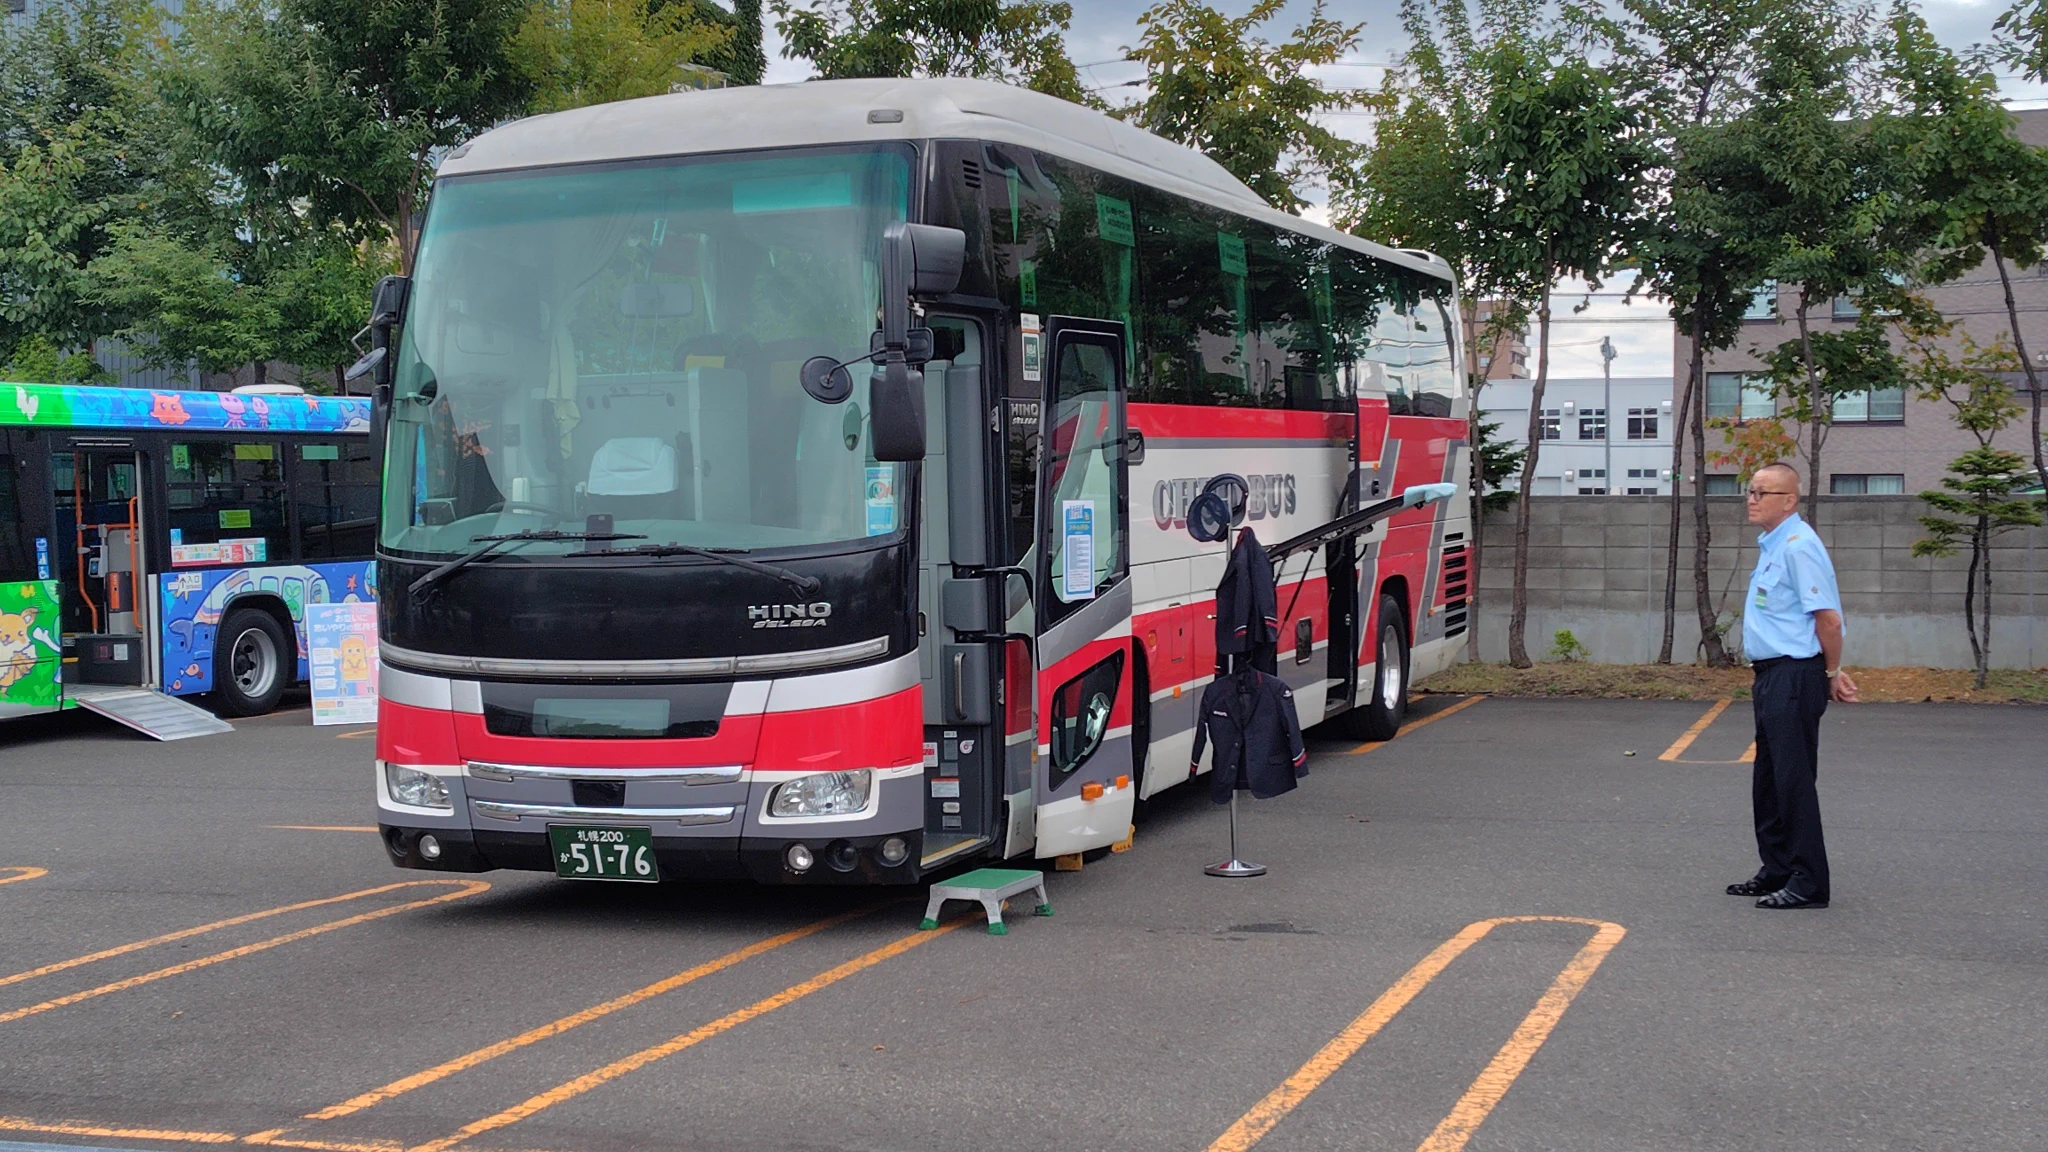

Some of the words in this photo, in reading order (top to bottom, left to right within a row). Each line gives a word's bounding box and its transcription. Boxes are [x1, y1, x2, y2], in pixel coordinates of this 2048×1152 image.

[1011, 403, 1039, 416] HINO
[1153, 477, 1242, 530] CH
[1247, 473, 1296, 520] BUS
[187, 575, 200, 583] 入口
[748, 602, 831, 619] HINO
[560, 852, 570, 863] か
[570, 843, 651, 875] 51-76
